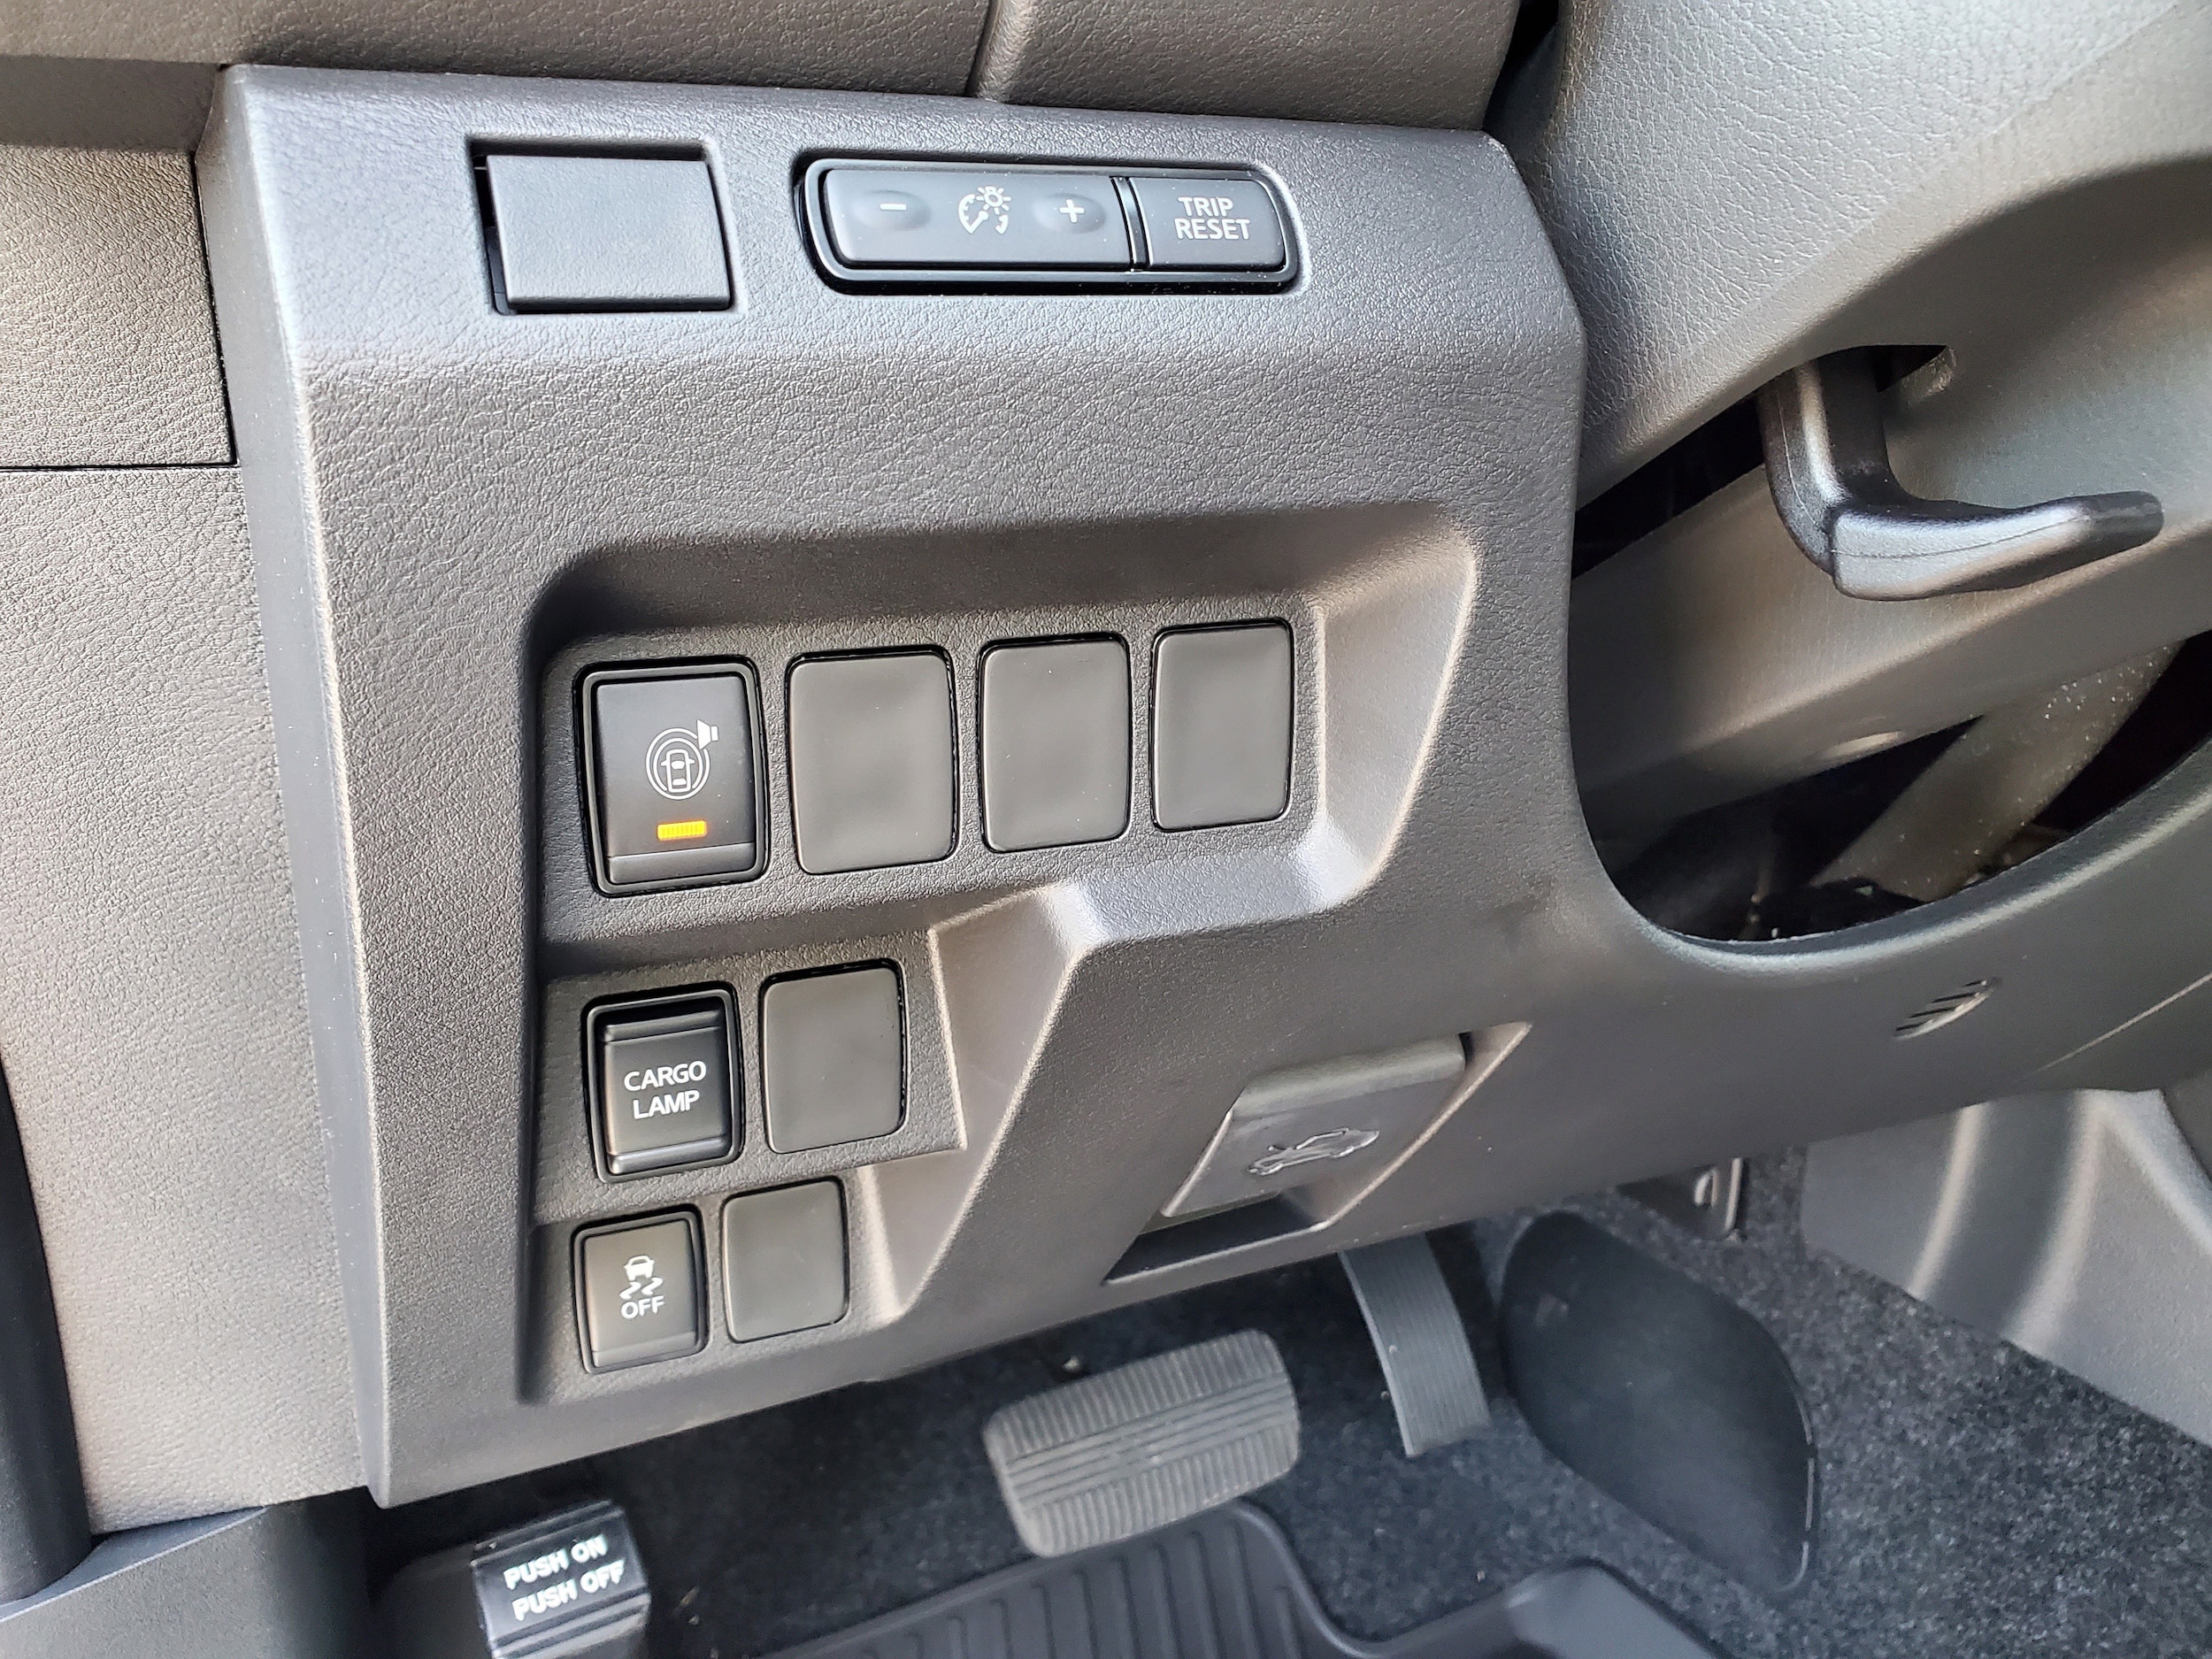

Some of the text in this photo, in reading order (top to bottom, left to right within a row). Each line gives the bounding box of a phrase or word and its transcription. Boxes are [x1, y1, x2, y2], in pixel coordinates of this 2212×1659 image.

[1177, 196, 1233, 217] TRIP
[1174, 218, 1250, 240] RESET
[624, 1061, 706, 1091] CARGO
[633, 1090, 700, 1119] LAMP
[621, 1295, 664, 1319] OFF
[503, 1534, 609, 1590] PUSH ON
[511, 1559, 625, 1621] PUSH OFF
